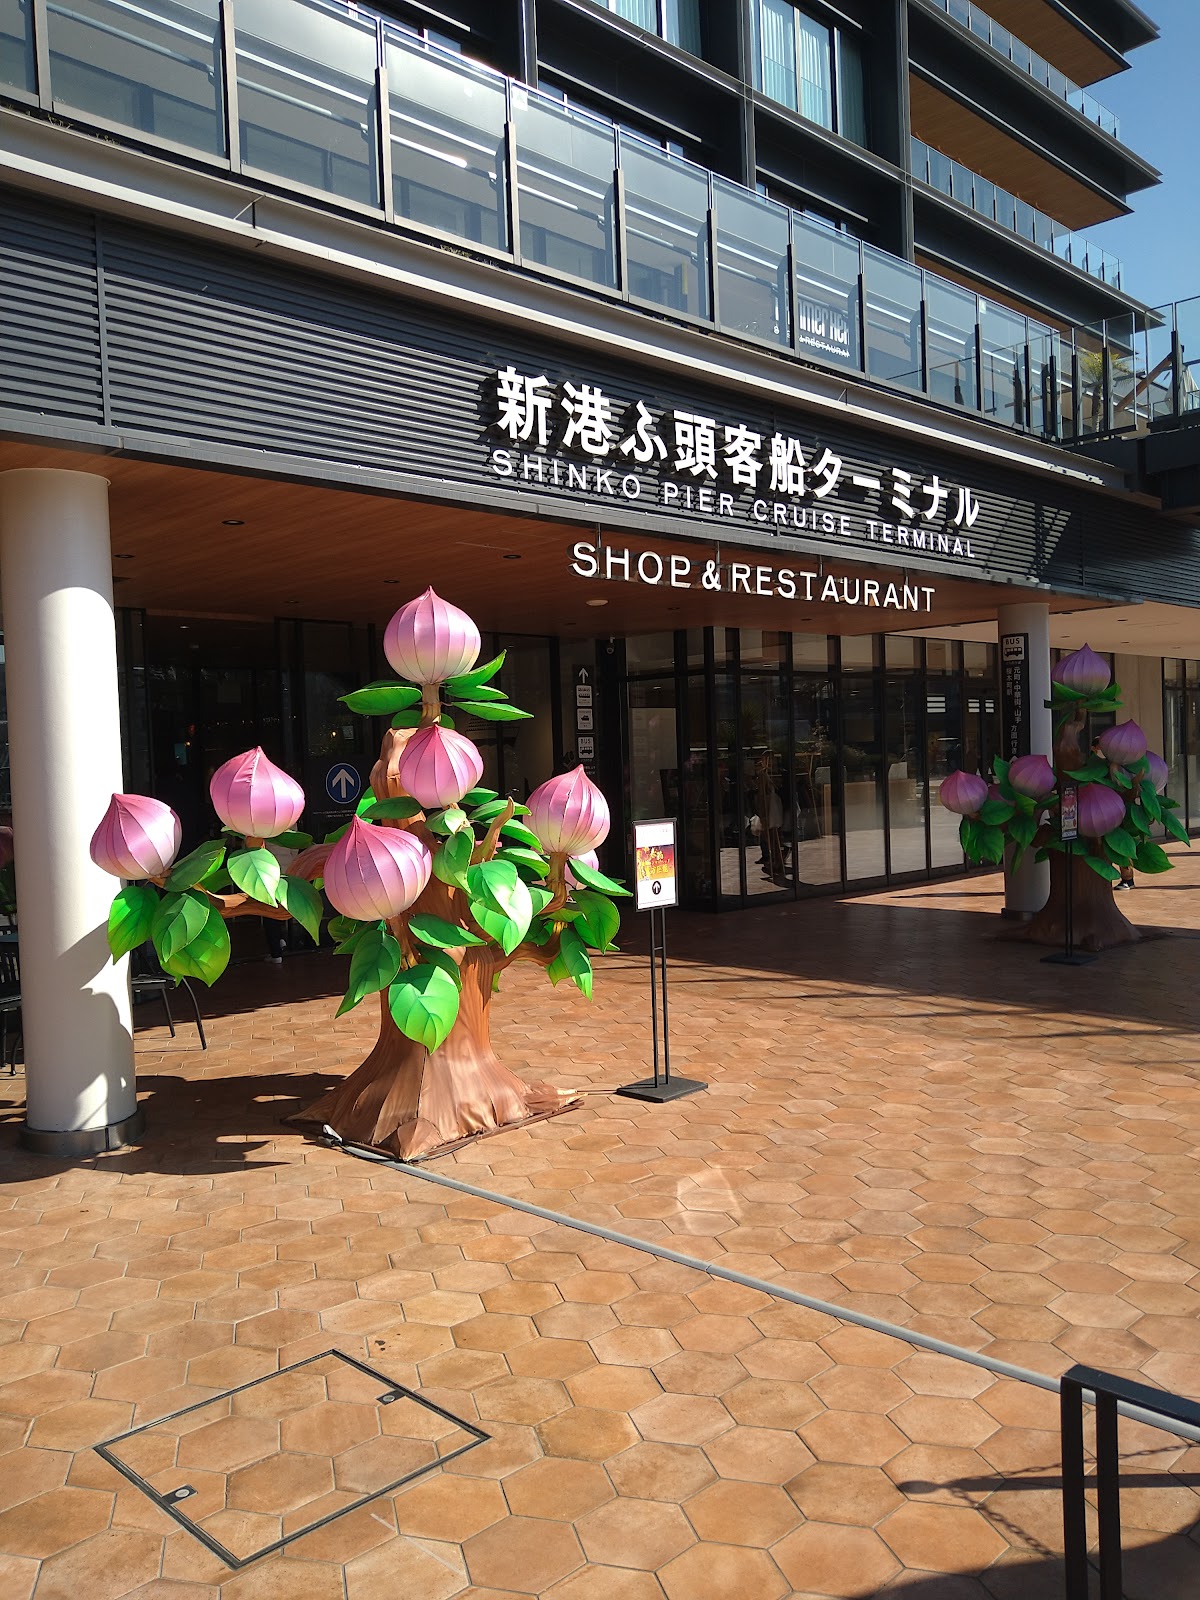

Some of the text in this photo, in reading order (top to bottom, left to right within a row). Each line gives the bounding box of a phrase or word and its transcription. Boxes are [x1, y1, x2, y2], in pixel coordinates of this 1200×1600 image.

[497, 365, 980, 528] 新港ふ頭客船ターミナル
[492, 449, 975, 559] SHINKO PIER CRUISE TERMINAL
[571, 541, 935, 612] SHOP & RESTAURANT
[1005, 637, 1020, 645] BUS
